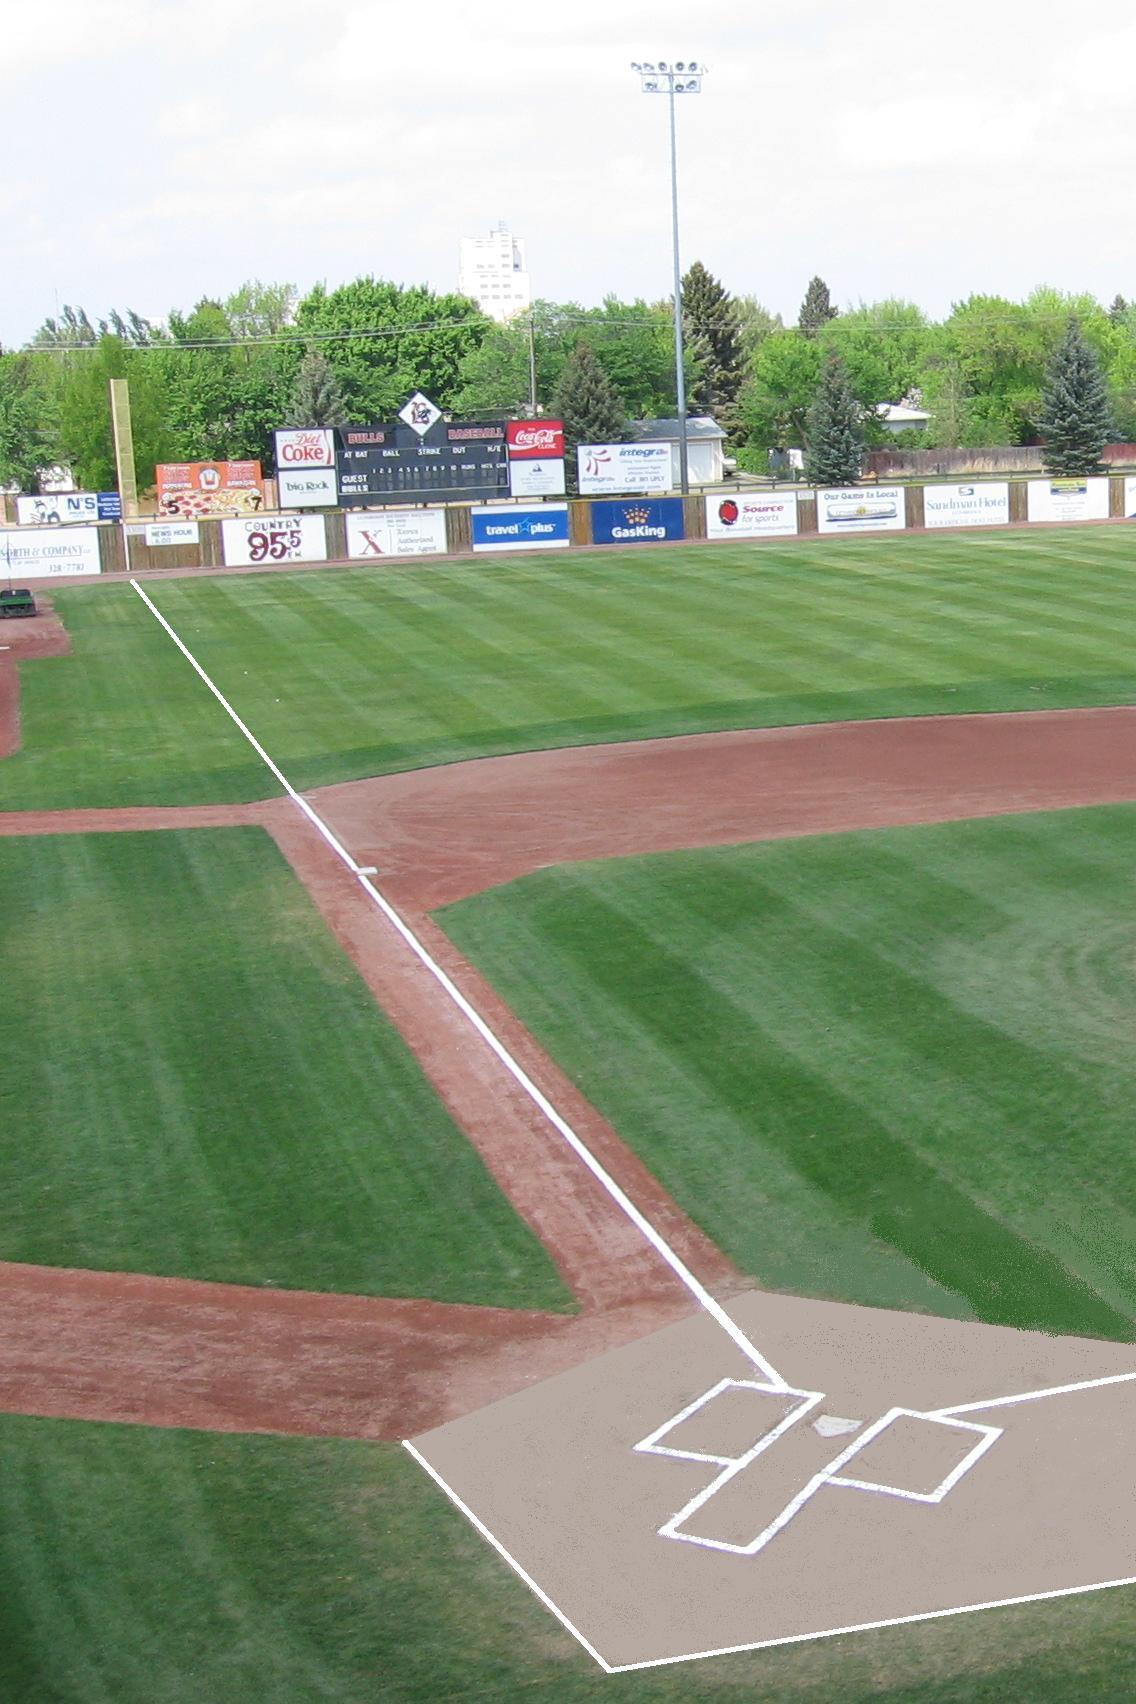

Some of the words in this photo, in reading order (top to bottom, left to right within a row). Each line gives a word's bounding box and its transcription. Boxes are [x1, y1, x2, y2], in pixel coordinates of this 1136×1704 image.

[347, 432, 385, 444] BULLS
[282, 444, 324, 461] Coke
[344, 450, 352, 459] AT
[382, 449, 400, 457] BALL
[452, 446, 466, 454] OUT
[341, 474, 368, 483] GUEST
[742, 505, 784, 513] Source
[927, 498, 977, 510] Sandman
[979, 497, 1006, 508] Hotel
[244, 518, 302, 532] COUNTRY
[754, 515, 780, 524] sports
[486, 523, 518, 535] travel
[530, 522, 554, 535] plus
[611, 525, 666, 538] GasKing
[42, 545, 82, 556] COMPANY
